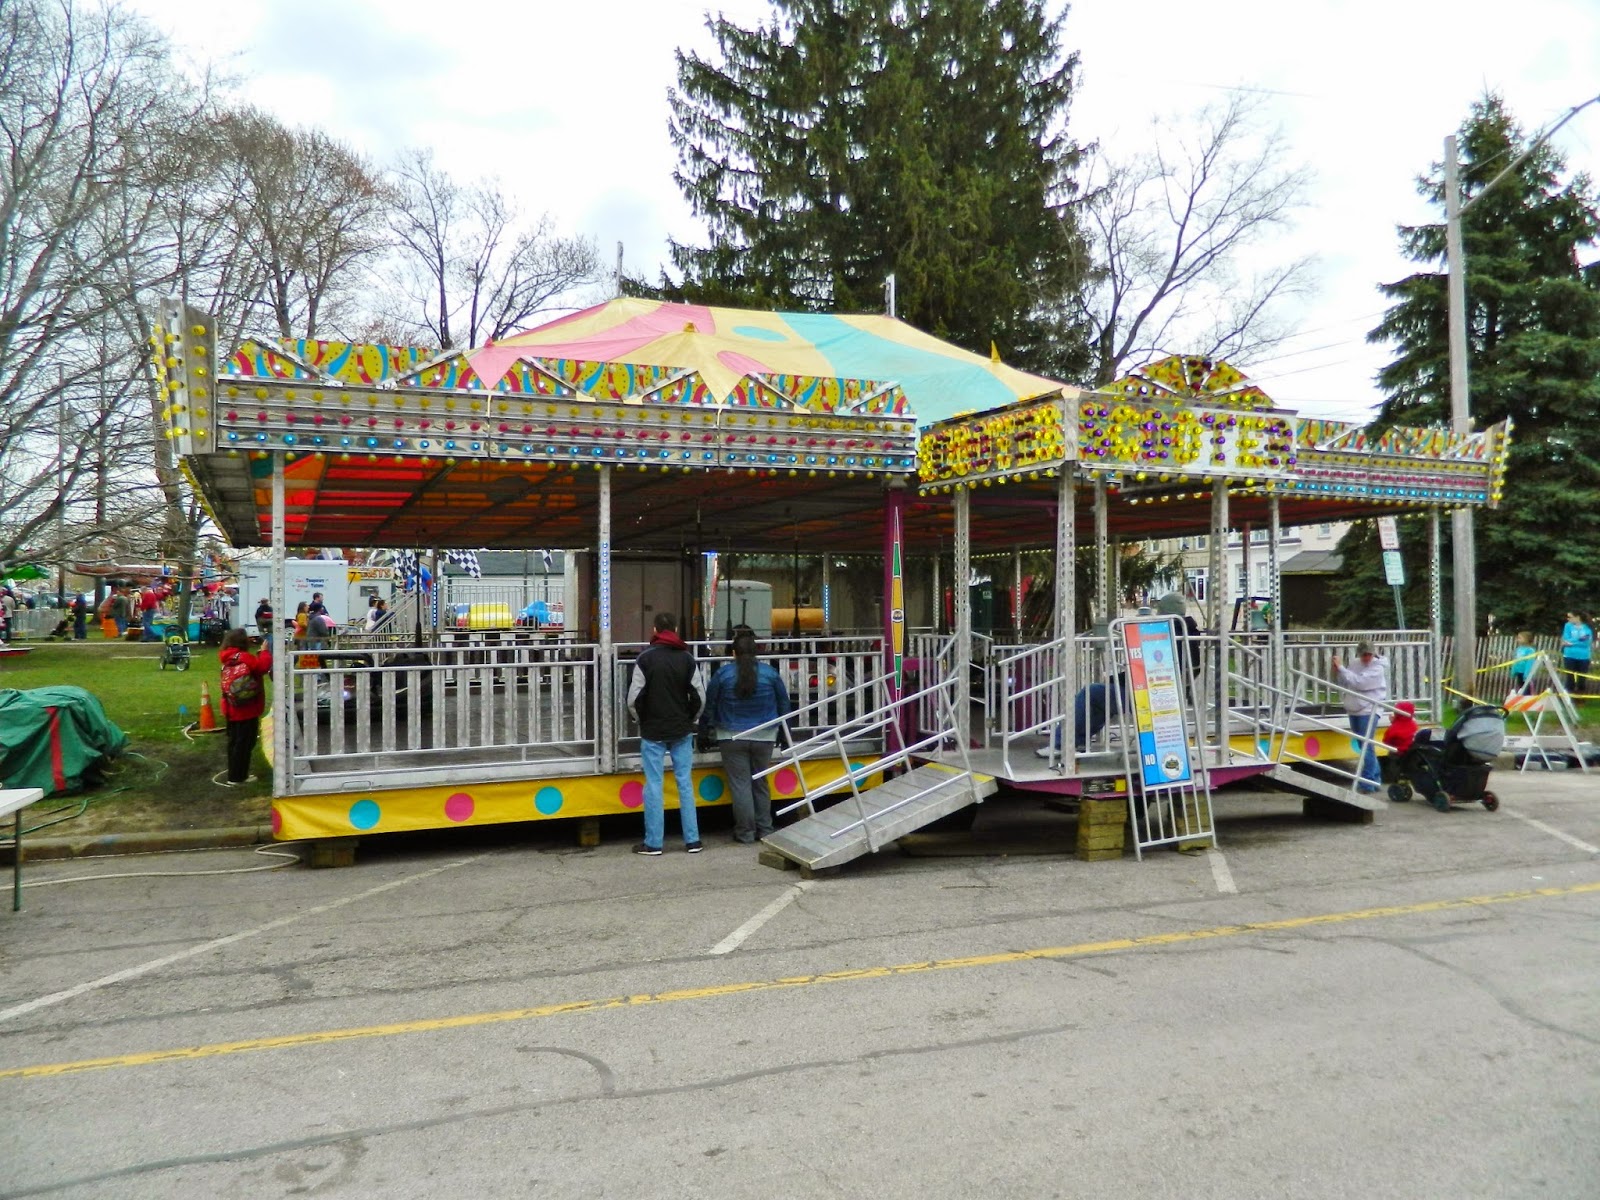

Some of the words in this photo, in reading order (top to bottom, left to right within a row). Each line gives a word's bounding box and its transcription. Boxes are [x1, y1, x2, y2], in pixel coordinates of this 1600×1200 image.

[1078, 400, 1298, 472] SCOOTER
[1129, 647, 1142, 659] YES
[1145, 754, 1156, 765] NO
